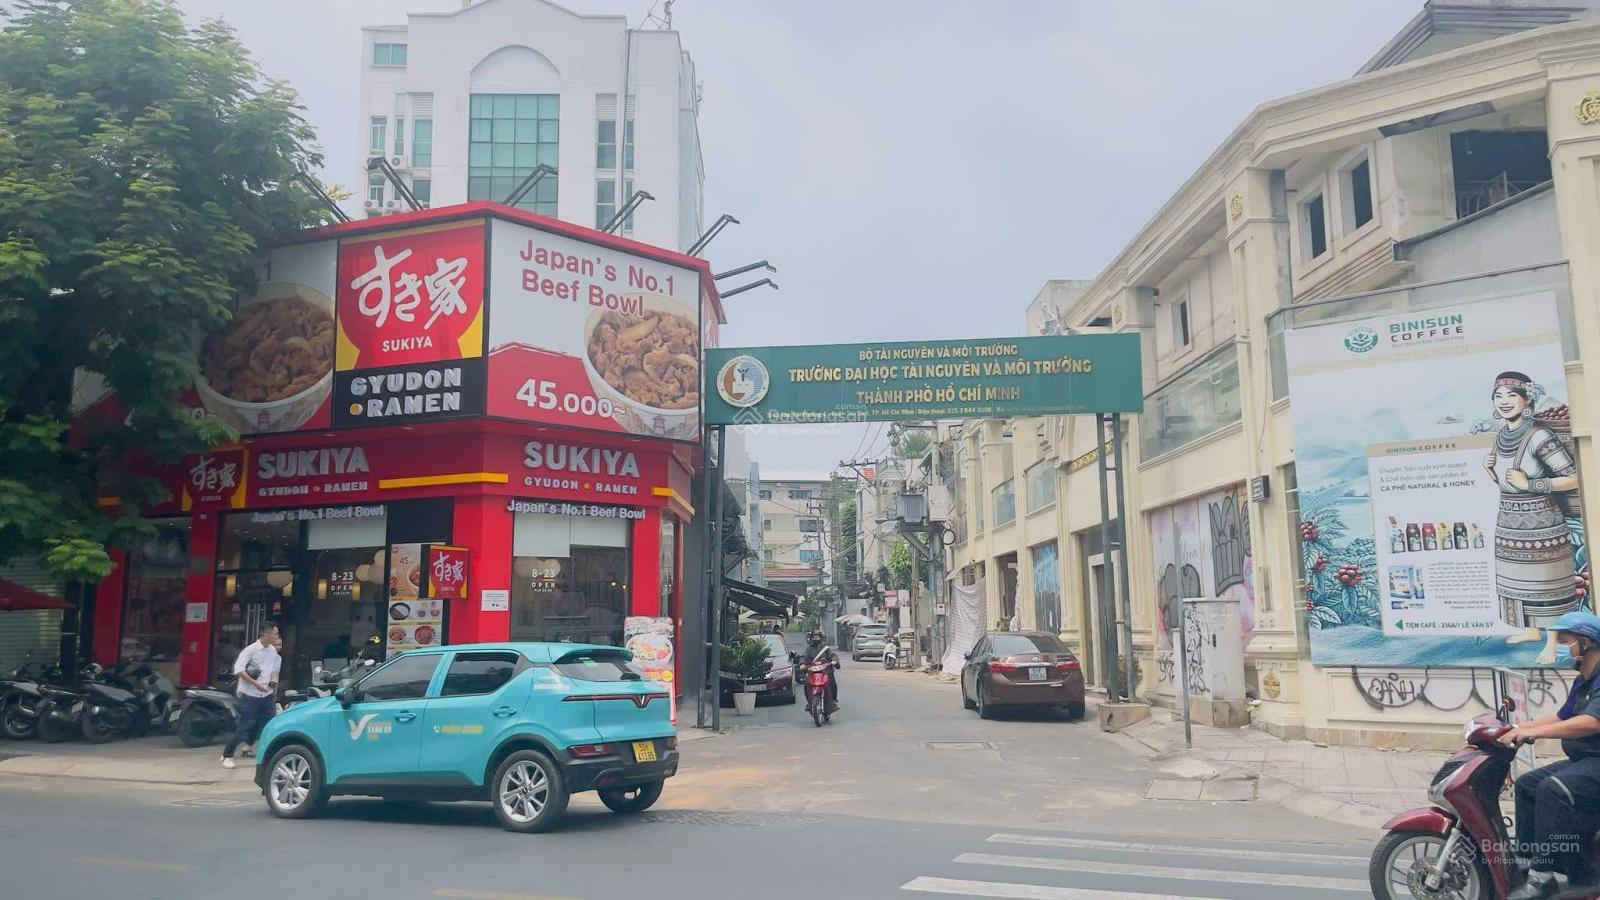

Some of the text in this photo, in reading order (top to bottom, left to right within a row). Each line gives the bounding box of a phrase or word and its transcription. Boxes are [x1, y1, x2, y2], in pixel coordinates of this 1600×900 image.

[520, 239, 675, 296] Japan's No.1
[351, 245, 469, 330] すき家
[522, 269, 645, 317] Beef Bowl
[1389, 314, 1463, 334] BINISUN
[1391, 325, 1464, 343] COFFEE
[382, 336, 433, 352] SUKIYA
[859, 342, 1018, 363] BỘ TÀI NGUYÊN VÀ MÔI TRƯỜNG
[789, 356, 1092, 385] TRƯỜNG ĐẠI HỌC TÀI NGUYÊN VÀ MÔI TRƯỜNG
[351, 368, 462, 396] GYUDON
[857, 382, 1020, 404] THÀNH PHỐ HỒ CHÍ MINH
[366, 392, 462, 417] RAMEN
[257, 447, 370, 479] SUKIYA
[524, 441, 640, 478] SUKIYA
[259, 481, 368, 497] GYUDON RAMEN
[524, 476, 638, 495] GYUDON RAMEN
[1408, 482, 1440, 490] NATURAL
[298, 508, 322, 520] No.1
[325, 507, 352, 519] Beef
[355, 504, 384, 517] Bowl
[507, 499, 646, 520] Japan's No.1 Beef Bowl
[332, 571, 354, 582] 8-23
[433, 551, 464, 585] すき家
